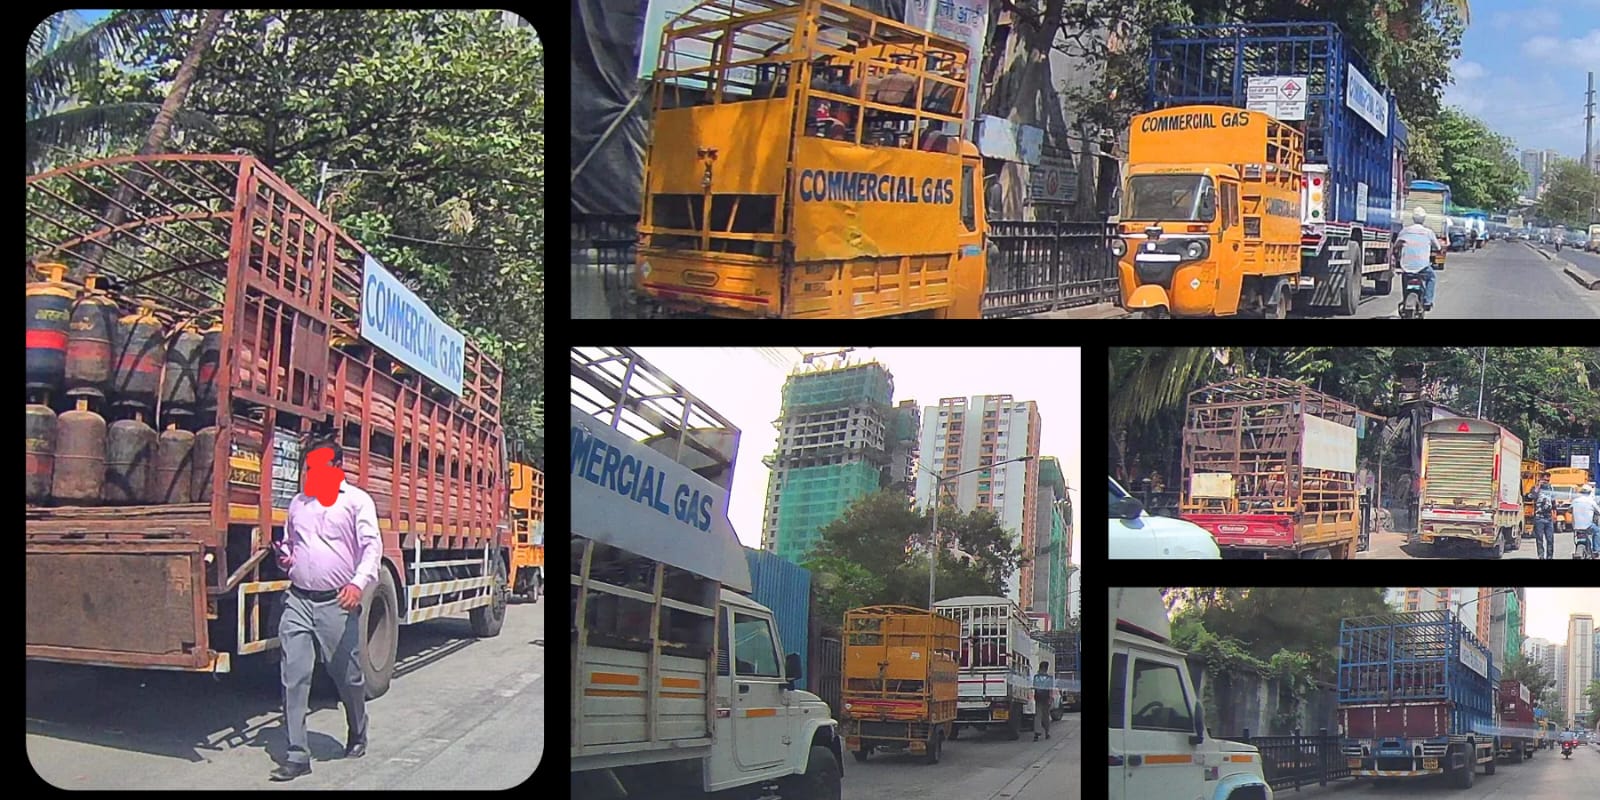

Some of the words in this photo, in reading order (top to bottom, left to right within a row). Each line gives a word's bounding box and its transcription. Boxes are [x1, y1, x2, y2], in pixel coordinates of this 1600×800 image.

[1141, 113, 1217, 133] COMMERCIAL
[1221, 111, 1250, 128] GAS
[800, 169, 918, 203] COMMERCIAL
[922, 178, 954, 204] GAS
[366, 274, 438, 368] COMMERCIAL
[440, 334, 461, 384] GAS
[570, 426, 669, 516] MERCIAL
